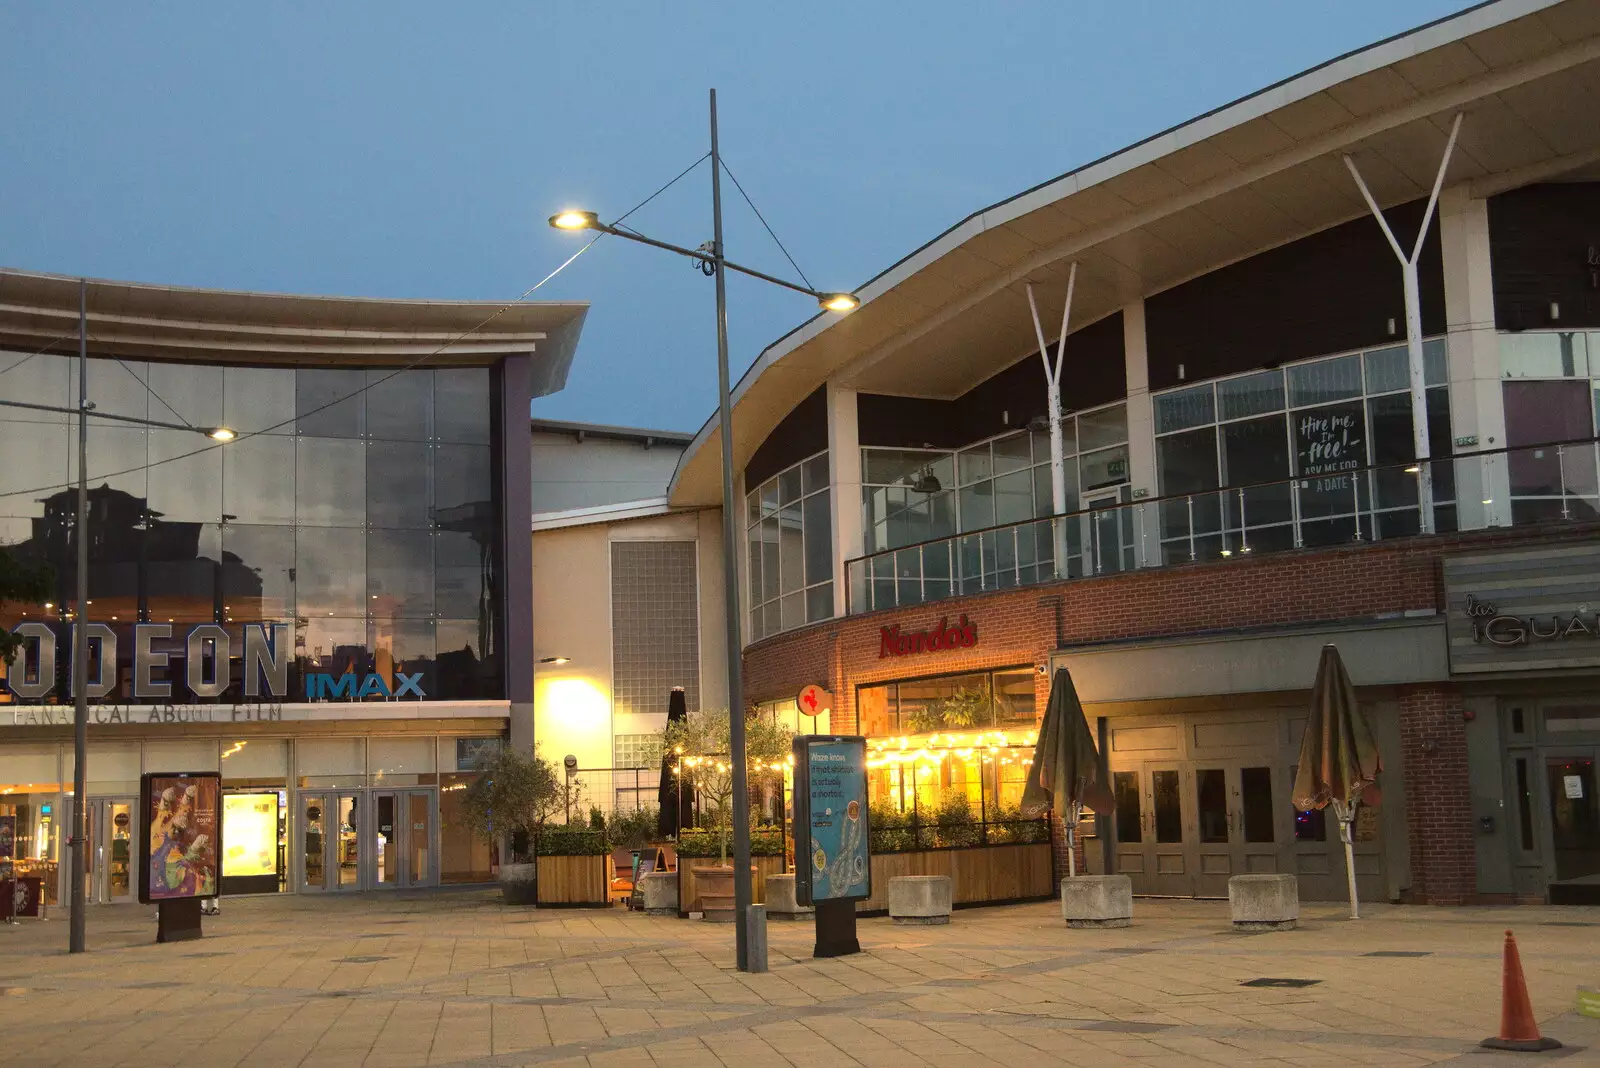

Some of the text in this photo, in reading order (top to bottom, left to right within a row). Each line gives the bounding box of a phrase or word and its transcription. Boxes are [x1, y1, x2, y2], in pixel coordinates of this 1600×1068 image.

[1300, 415, 1354, 440] Hire me,
[1321, 432, 1335, 443] I'm
[1309, 429, 1347, 464] free!
[1316, 477, 1348, 492] A DATE
[1465, 593, 1495, 616] las
[879, 614, 978, 659] Nando's
[1473, 613, 1600, 645] iGUA
[7, 622, 289, 699] ODEON
[305, 672, 427, 697] IMAX
[14, 702, 282, 725] FANAICAL ABOUT FILM
